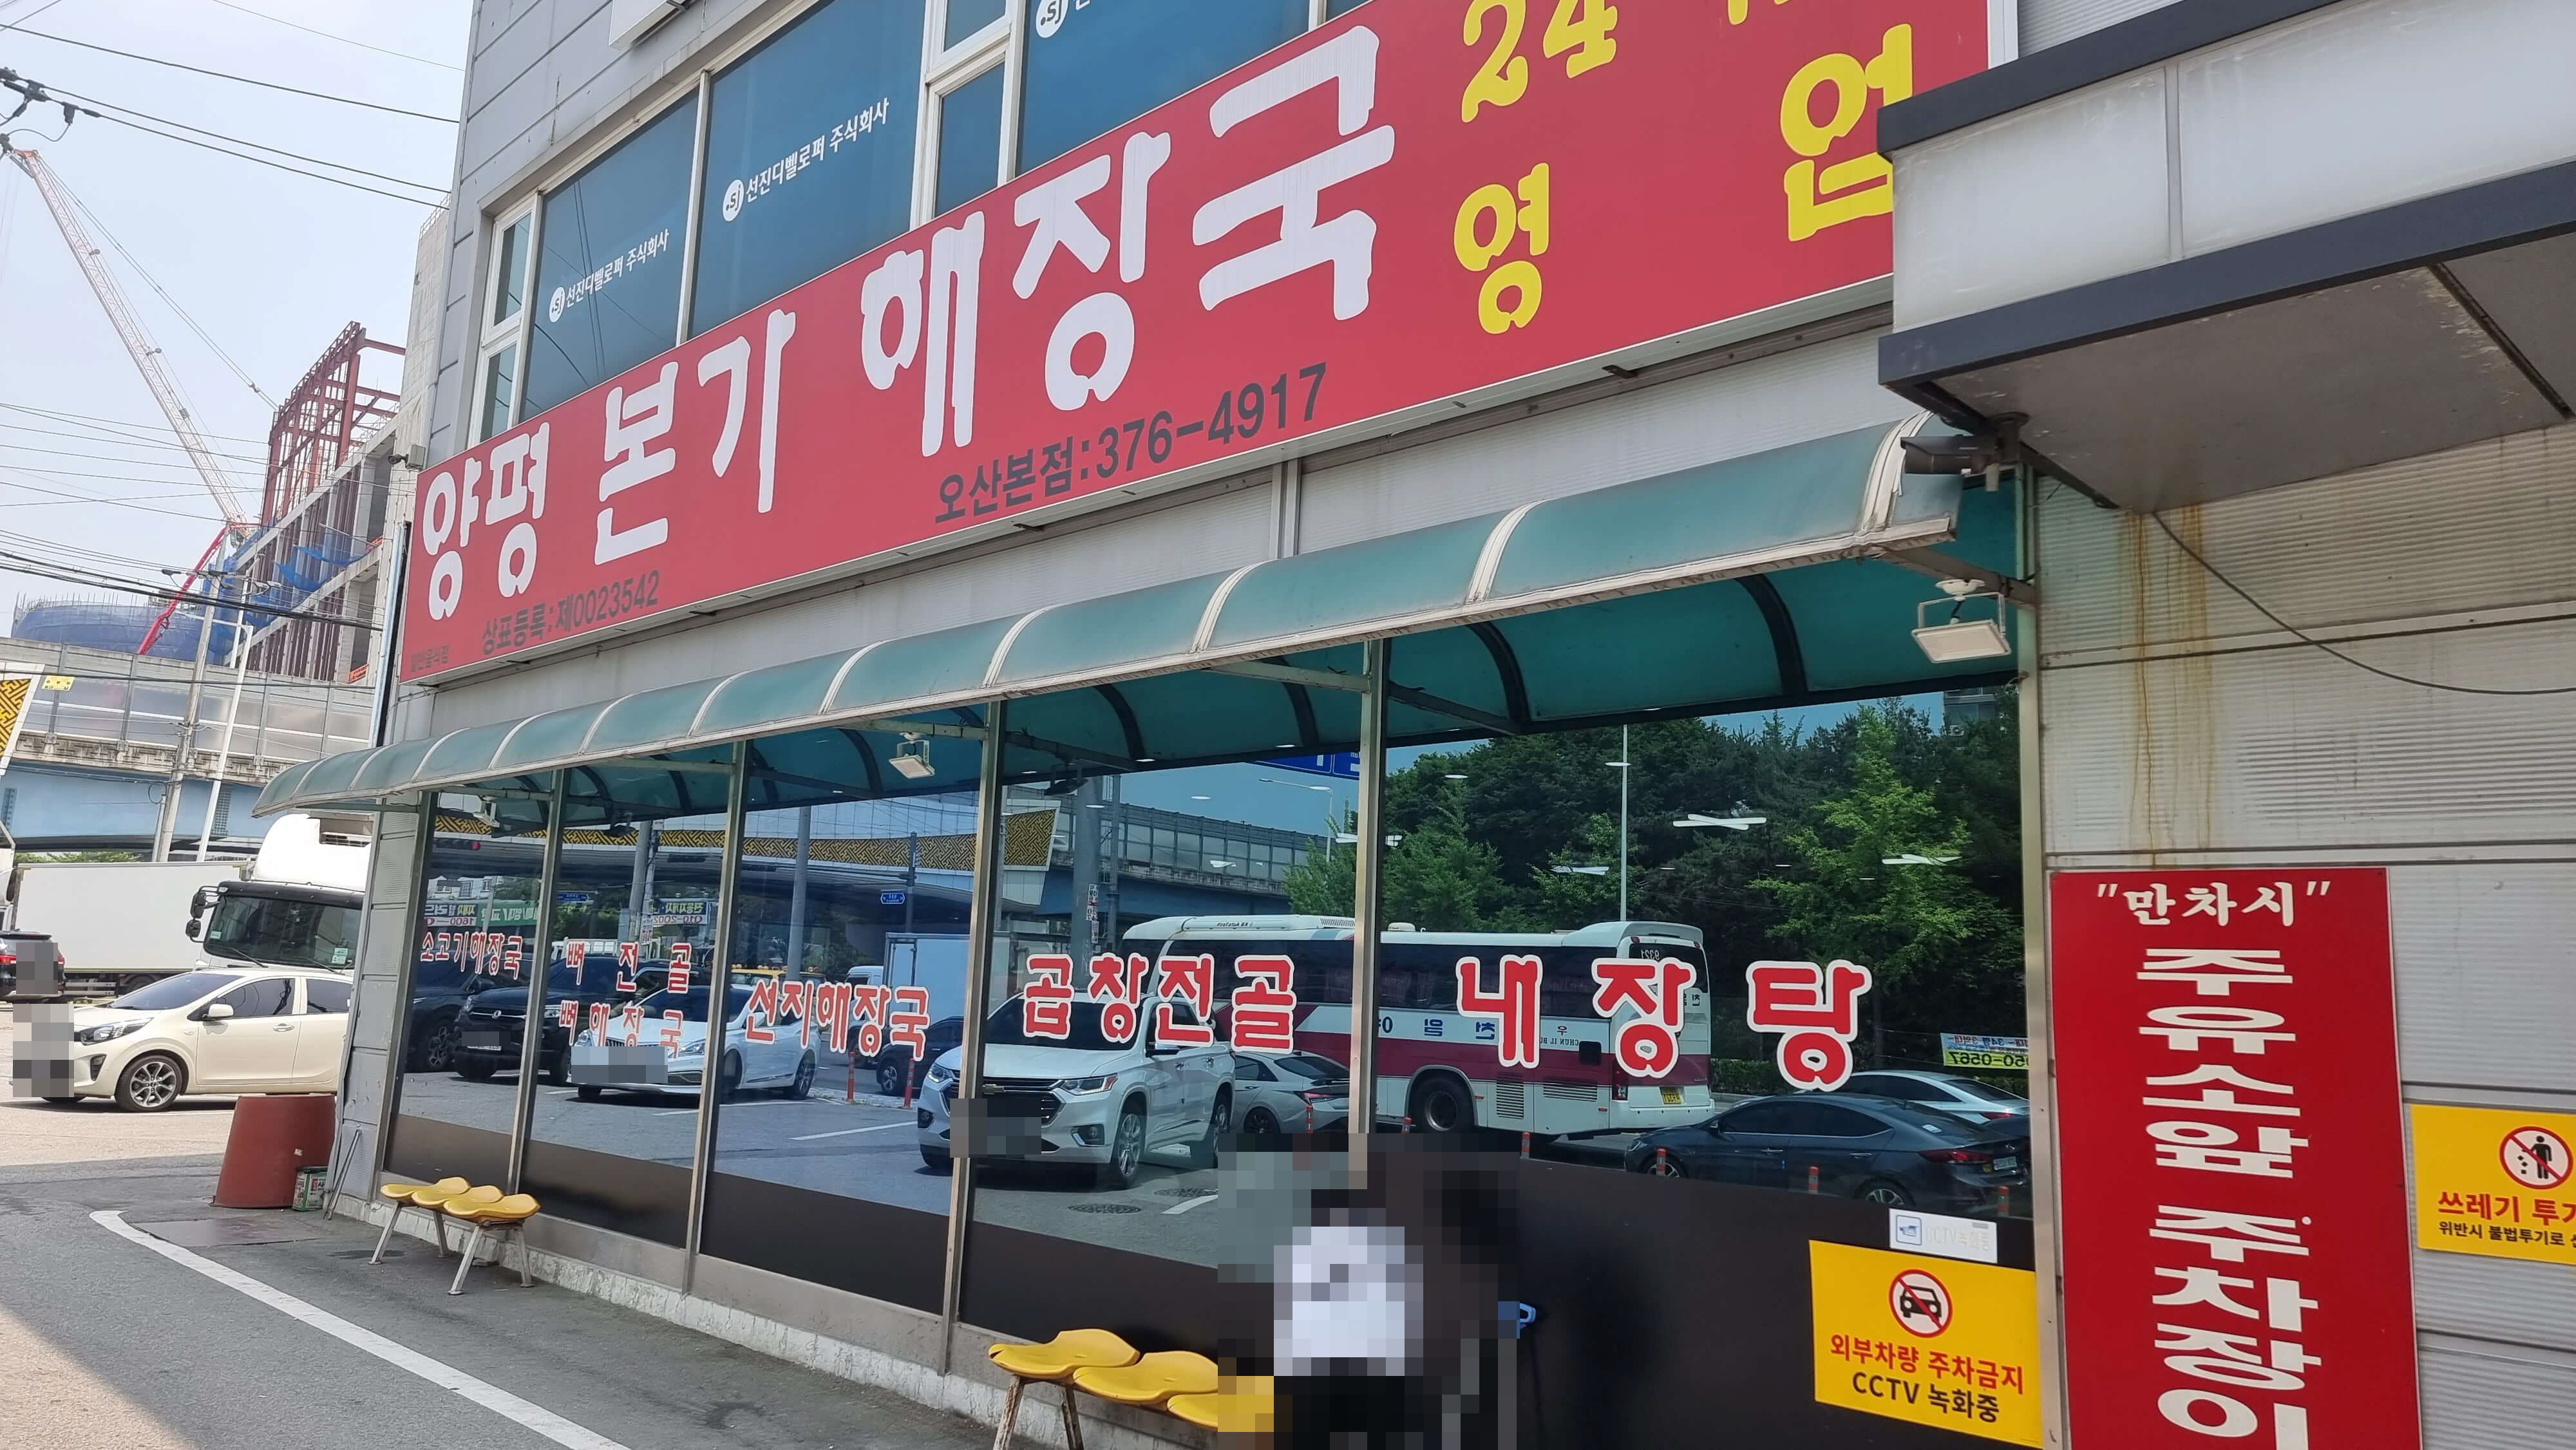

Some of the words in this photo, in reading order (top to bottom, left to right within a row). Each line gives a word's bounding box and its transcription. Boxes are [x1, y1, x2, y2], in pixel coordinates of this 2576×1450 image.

[1461, 0, 1618, 123] 24
[746, 135, 826, 203] 선진디벨로퍼
[829, 97, 889, 153] 주식회사
[566, 255, 624, 308] 선진디벨로퍼
[626, 228, 670, 272] 주식회사
[423, 422, 550, 620] 양평
[861, 26, 1395, 457] 해장국
[420, 931, 523, 980] 소고기해장국
[745, 979, 931, 1062] 선지해장국
[1023, 952, 1296, 1054] 곱창전골
[2136, 948, 2309, 1179] 주유소앞
[2438, 1192, 2520, 1223] 쓰레기
[2439, 1221, 2483, 1239] 위반시
[2488, 1225, 2565, 1247] 불법투기로
[1830, 1333, 1919, 1374] 외부차량
[1927, 1350, 2023, 1395] 주차금지
[1852, 1371, 1920, 1405] CCTV
[1927, 1384, 2000, 1423] 녹화중
